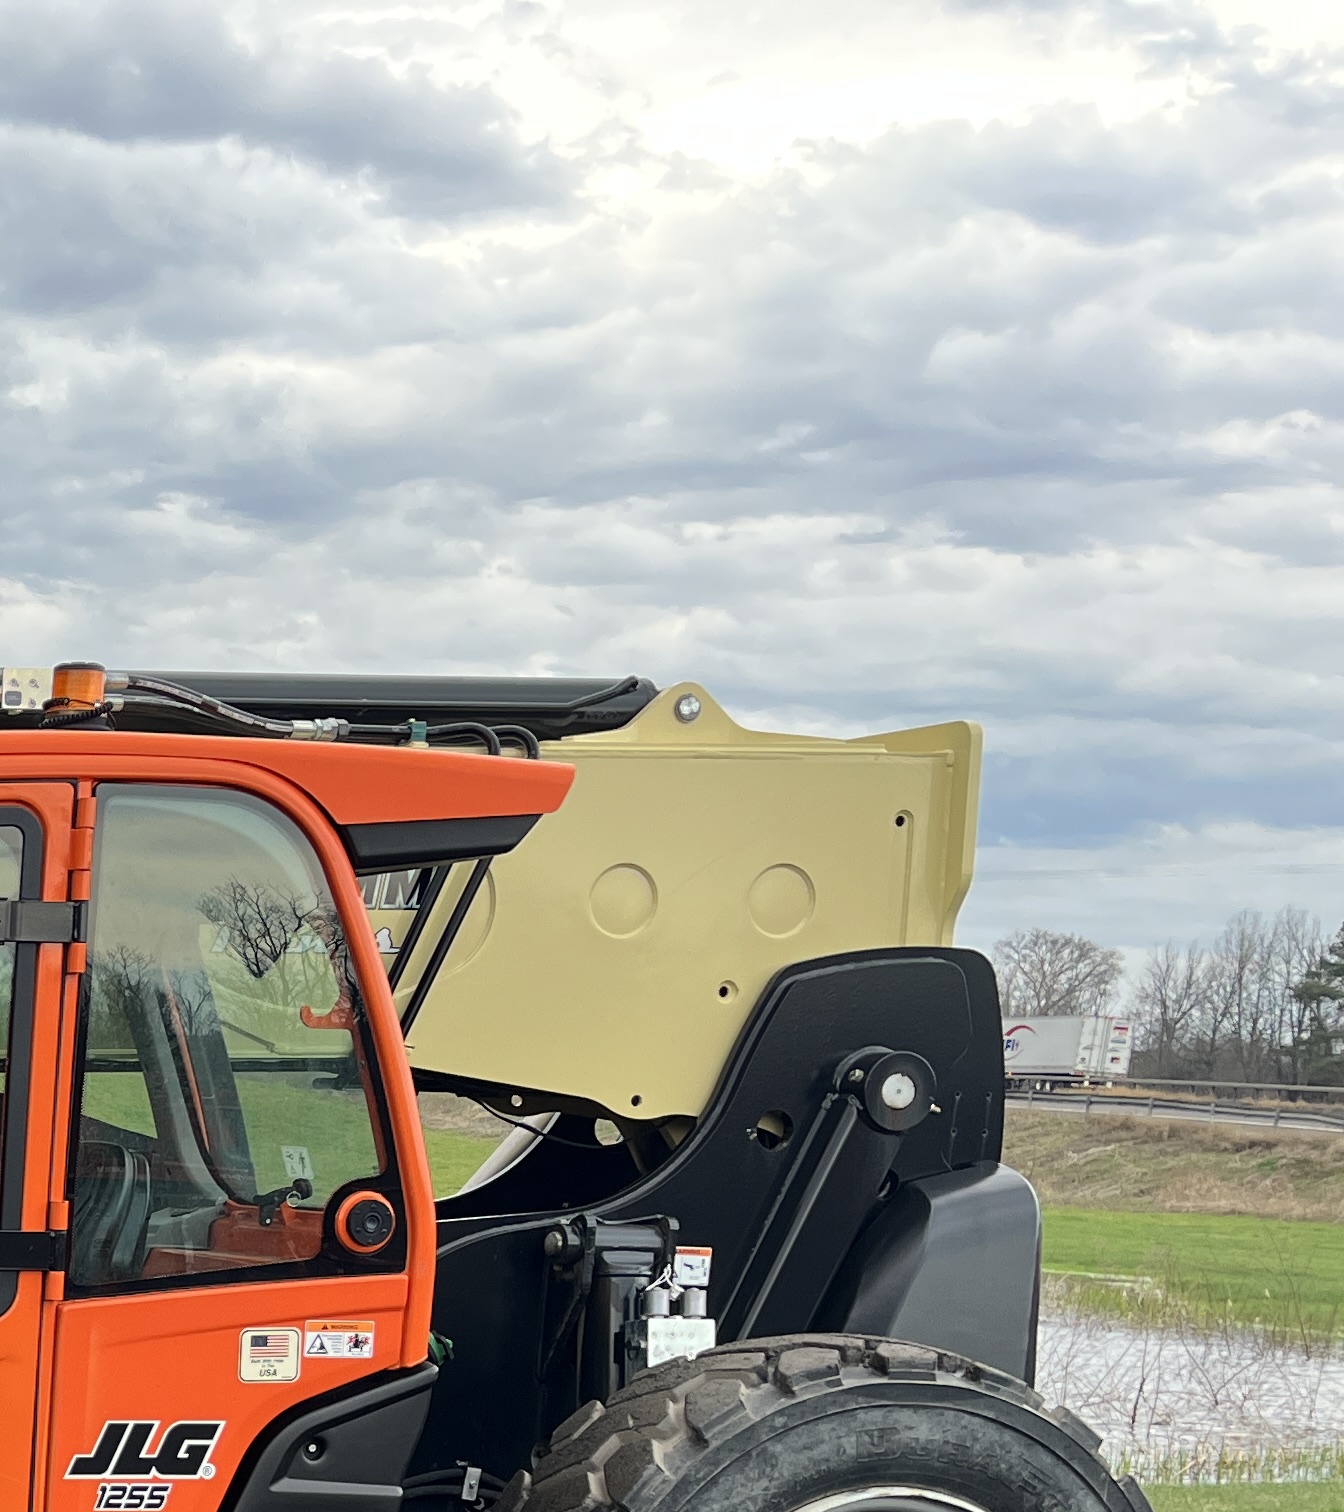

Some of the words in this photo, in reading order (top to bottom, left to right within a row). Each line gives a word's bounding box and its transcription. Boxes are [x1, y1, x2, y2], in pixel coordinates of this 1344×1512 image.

[259, 1369, 277, 1377] USA
[66, 1421, 225, 1478] JLG
[95, 1484, 171, 1510] 1255
